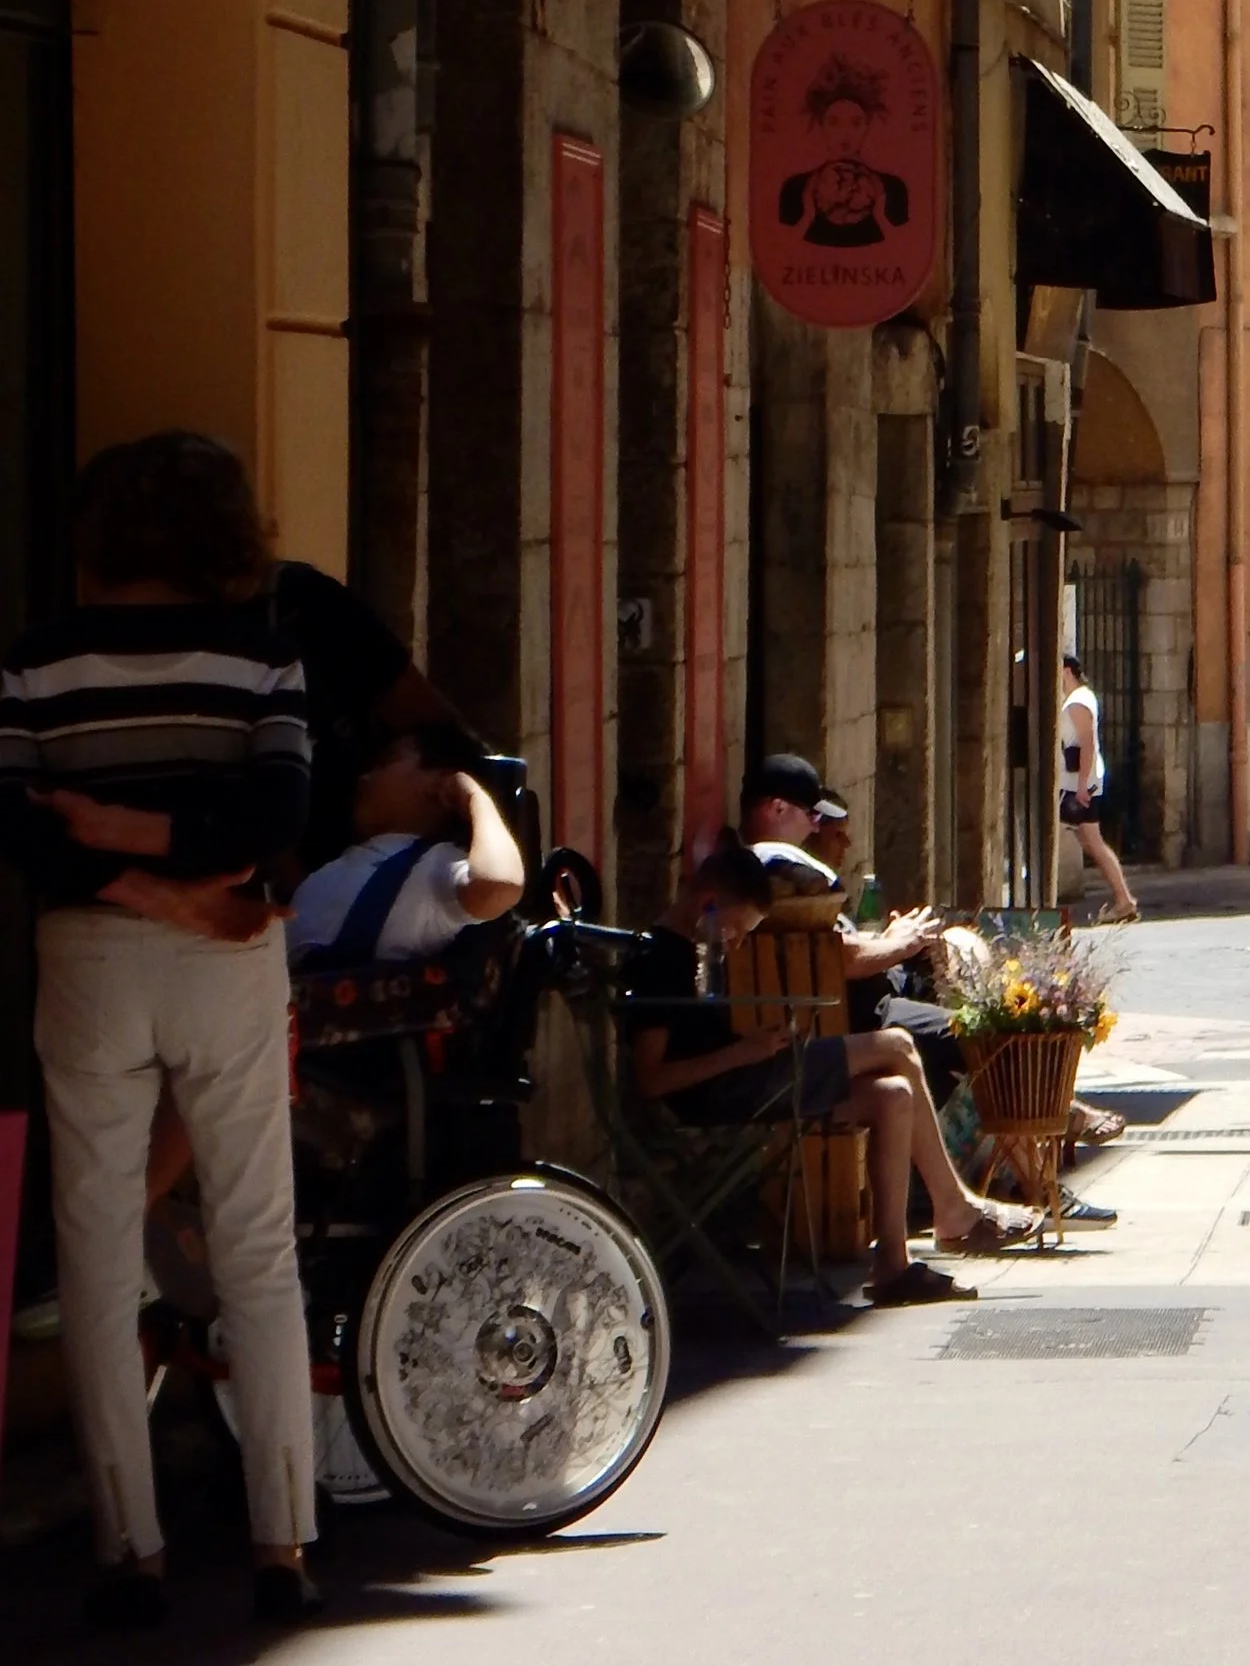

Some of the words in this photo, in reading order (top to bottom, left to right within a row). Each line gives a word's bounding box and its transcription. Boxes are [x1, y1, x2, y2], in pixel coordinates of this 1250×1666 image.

[761, 76, 777, 133] PAIN
[772, 24, 809, 65] AUX
[886, 32, 928, 133] ANCIENS
